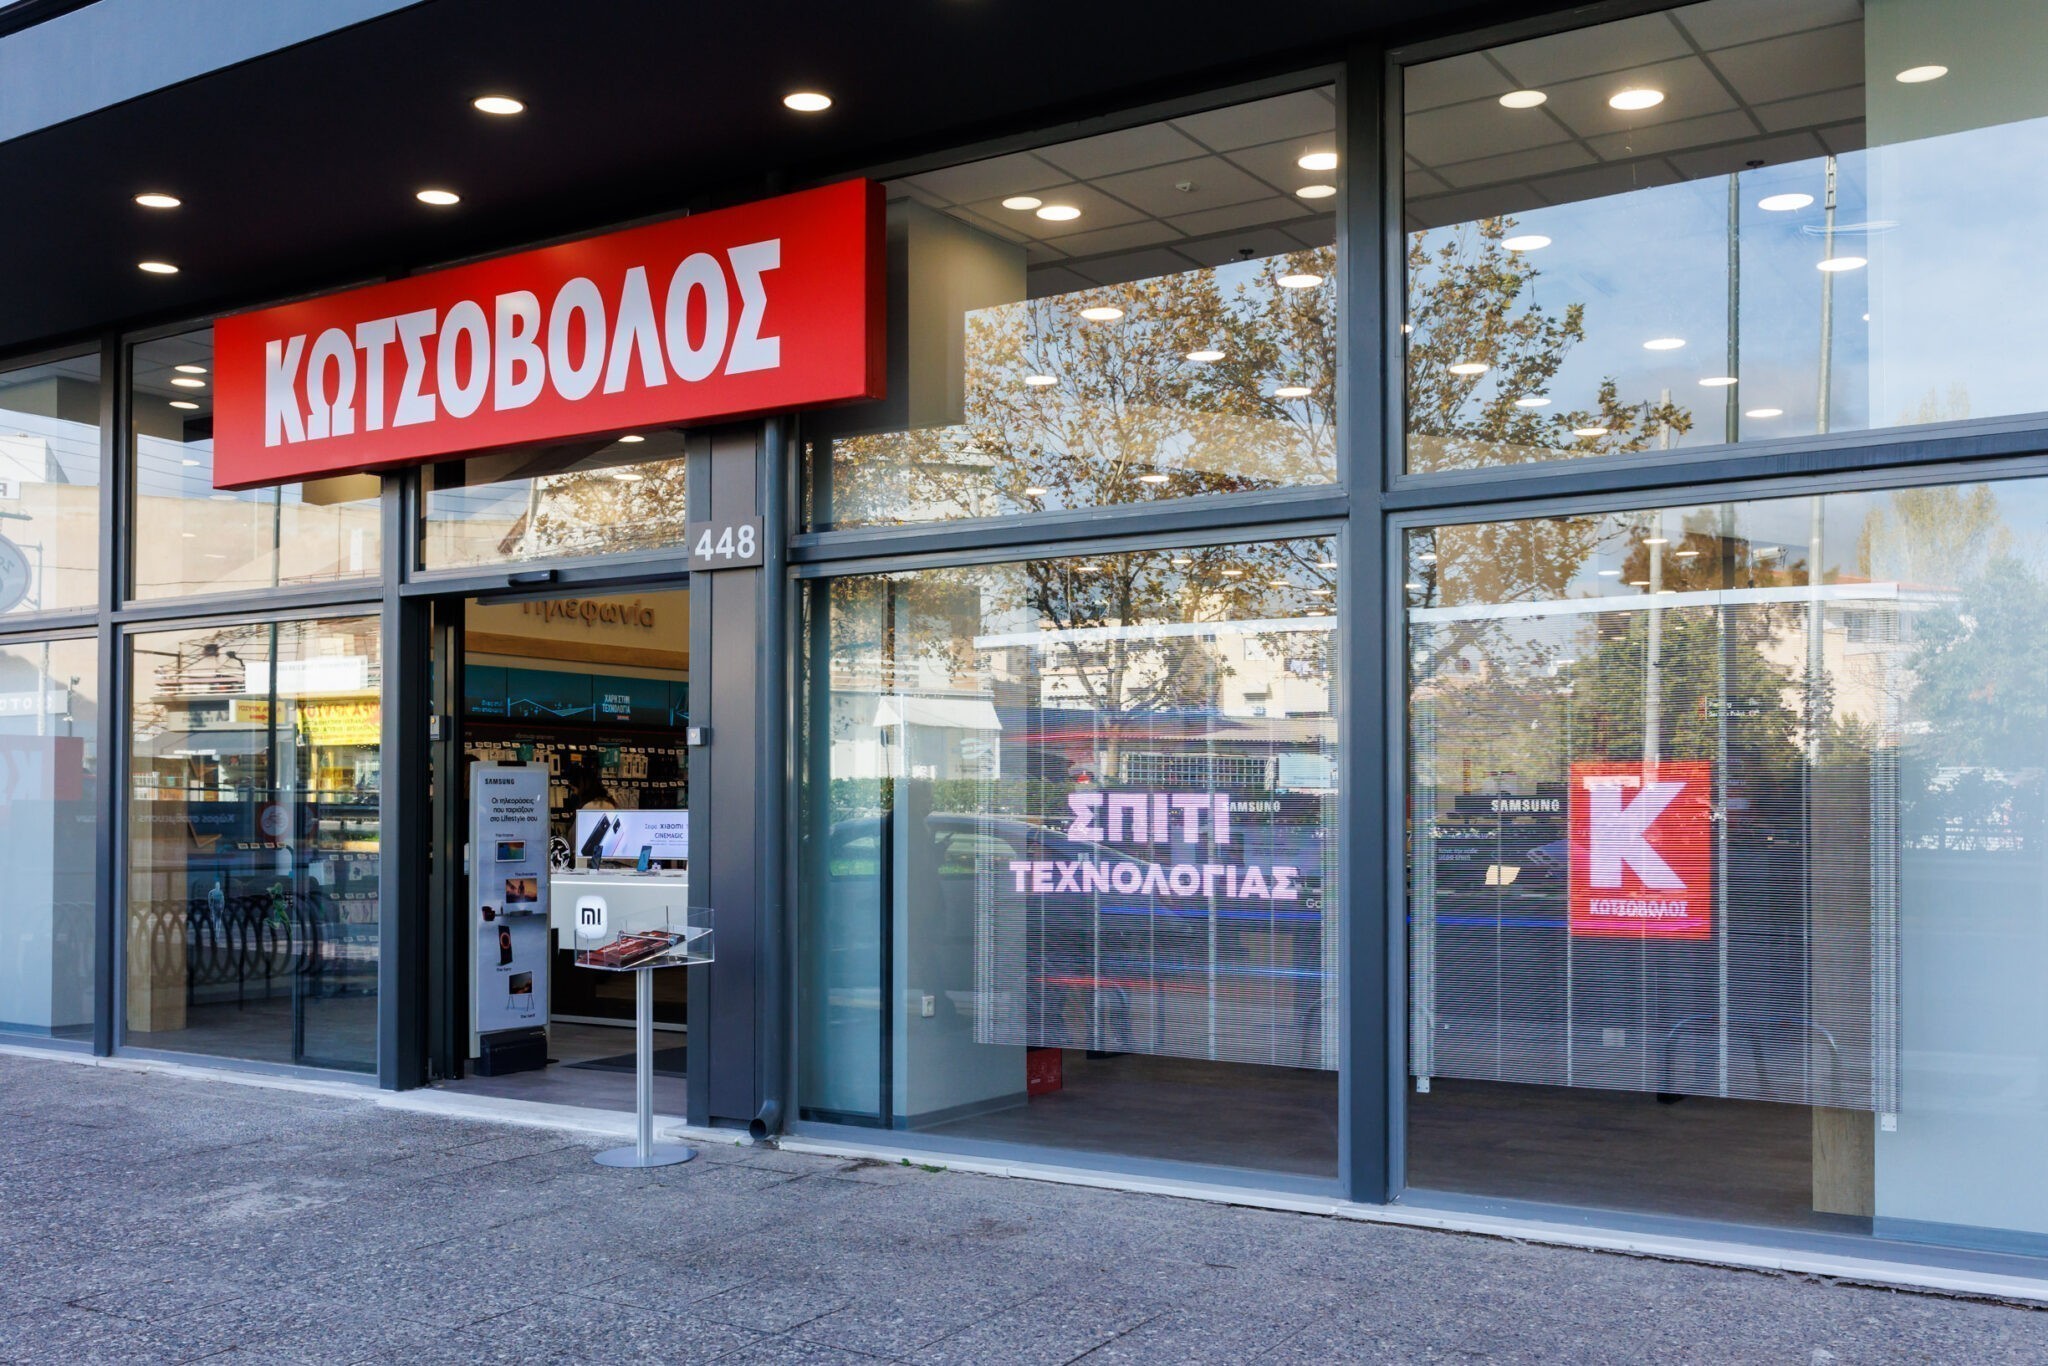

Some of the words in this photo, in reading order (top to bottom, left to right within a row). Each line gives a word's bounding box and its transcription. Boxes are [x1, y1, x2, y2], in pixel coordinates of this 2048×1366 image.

[264, 238, 781, 447] ΚΩΤΣΟΒΟΛΟΣ
[694, 524, 755, 563] 448
[501, 815, 525, 824] Lifestyle
[1068, 792, 1230, 844] ΣΠΙΤΙ
[1491, 799, 1560, 812] SAMSUNG
[1009, 859, 1299, 899] ΤΕΧΝΟΛΟΓΙΑΣ
